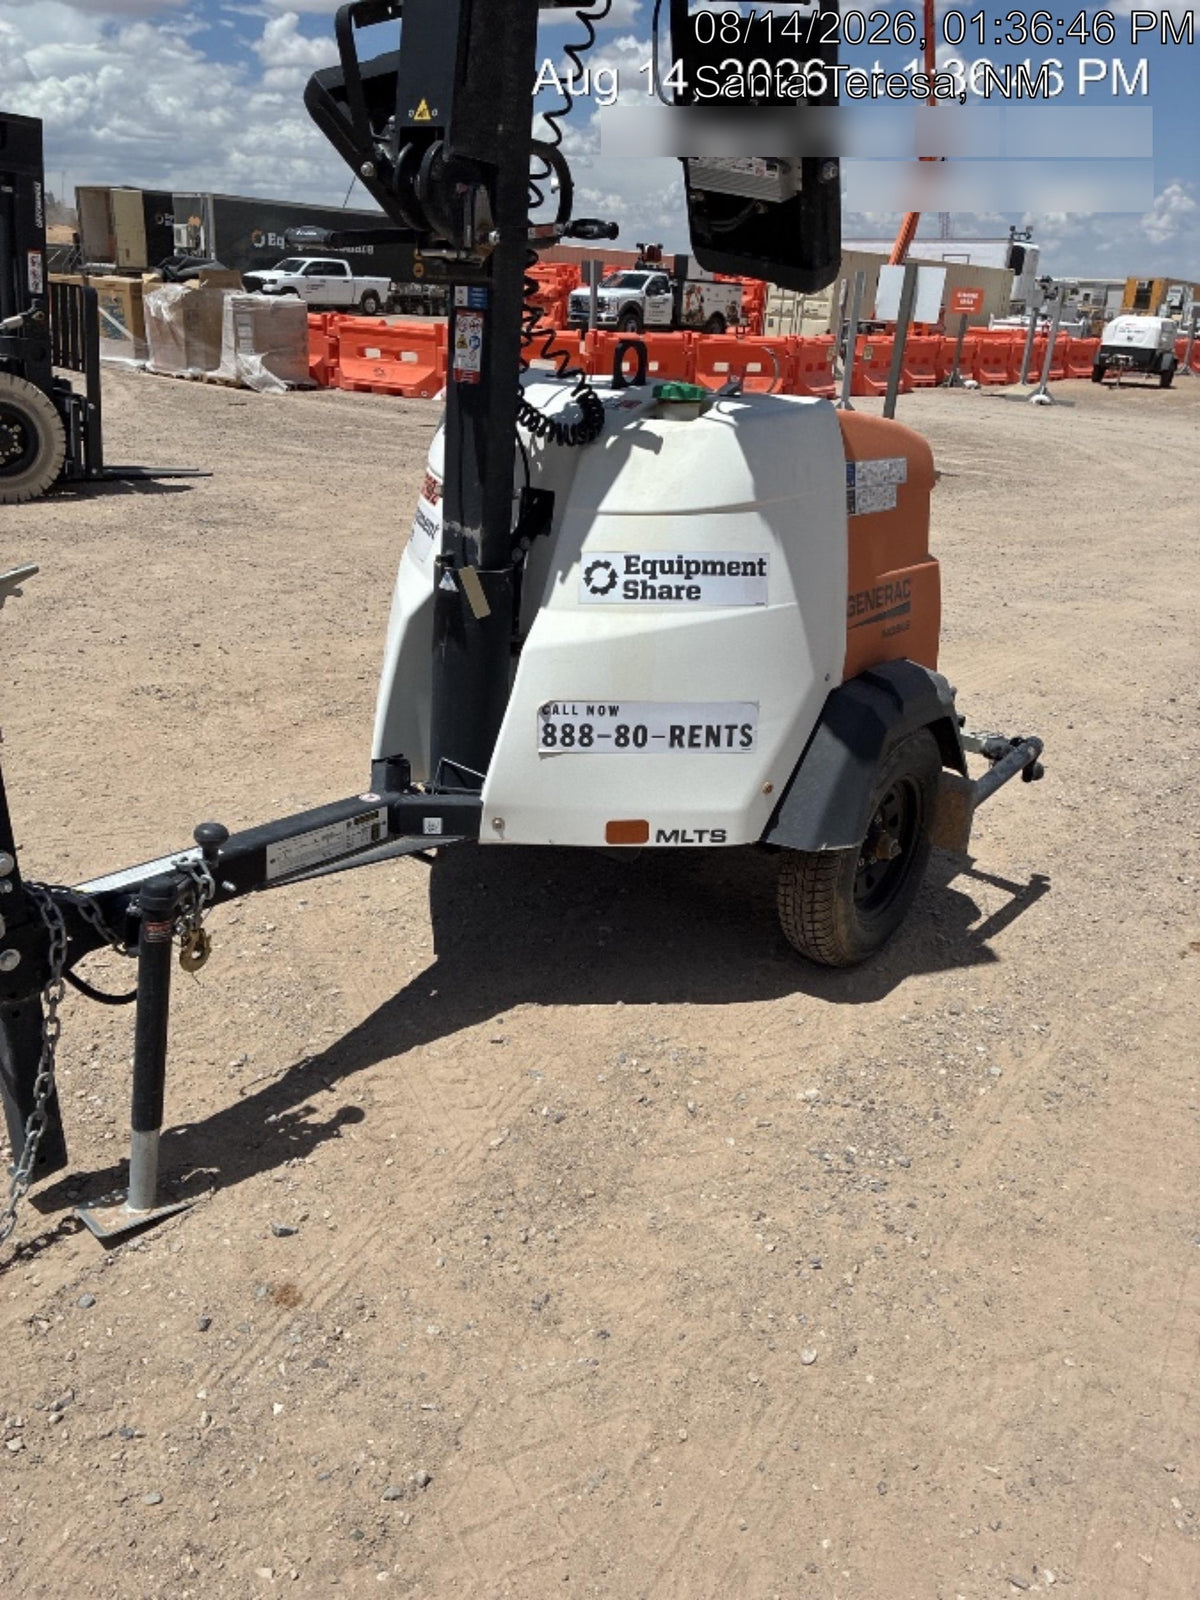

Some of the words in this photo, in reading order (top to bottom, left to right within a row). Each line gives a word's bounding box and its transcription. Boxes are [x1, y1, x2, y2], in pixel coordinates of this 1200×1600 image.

[623, 554, 767, 580] Equipment
[622, 579, 701, 600] Share
[541, 705, 579, 716] CALL
[586, 705, 620, 717] NOW
[541, 723, 753, 748] 888-80-RENTS
[655, 829, 727, 844] MLTS
